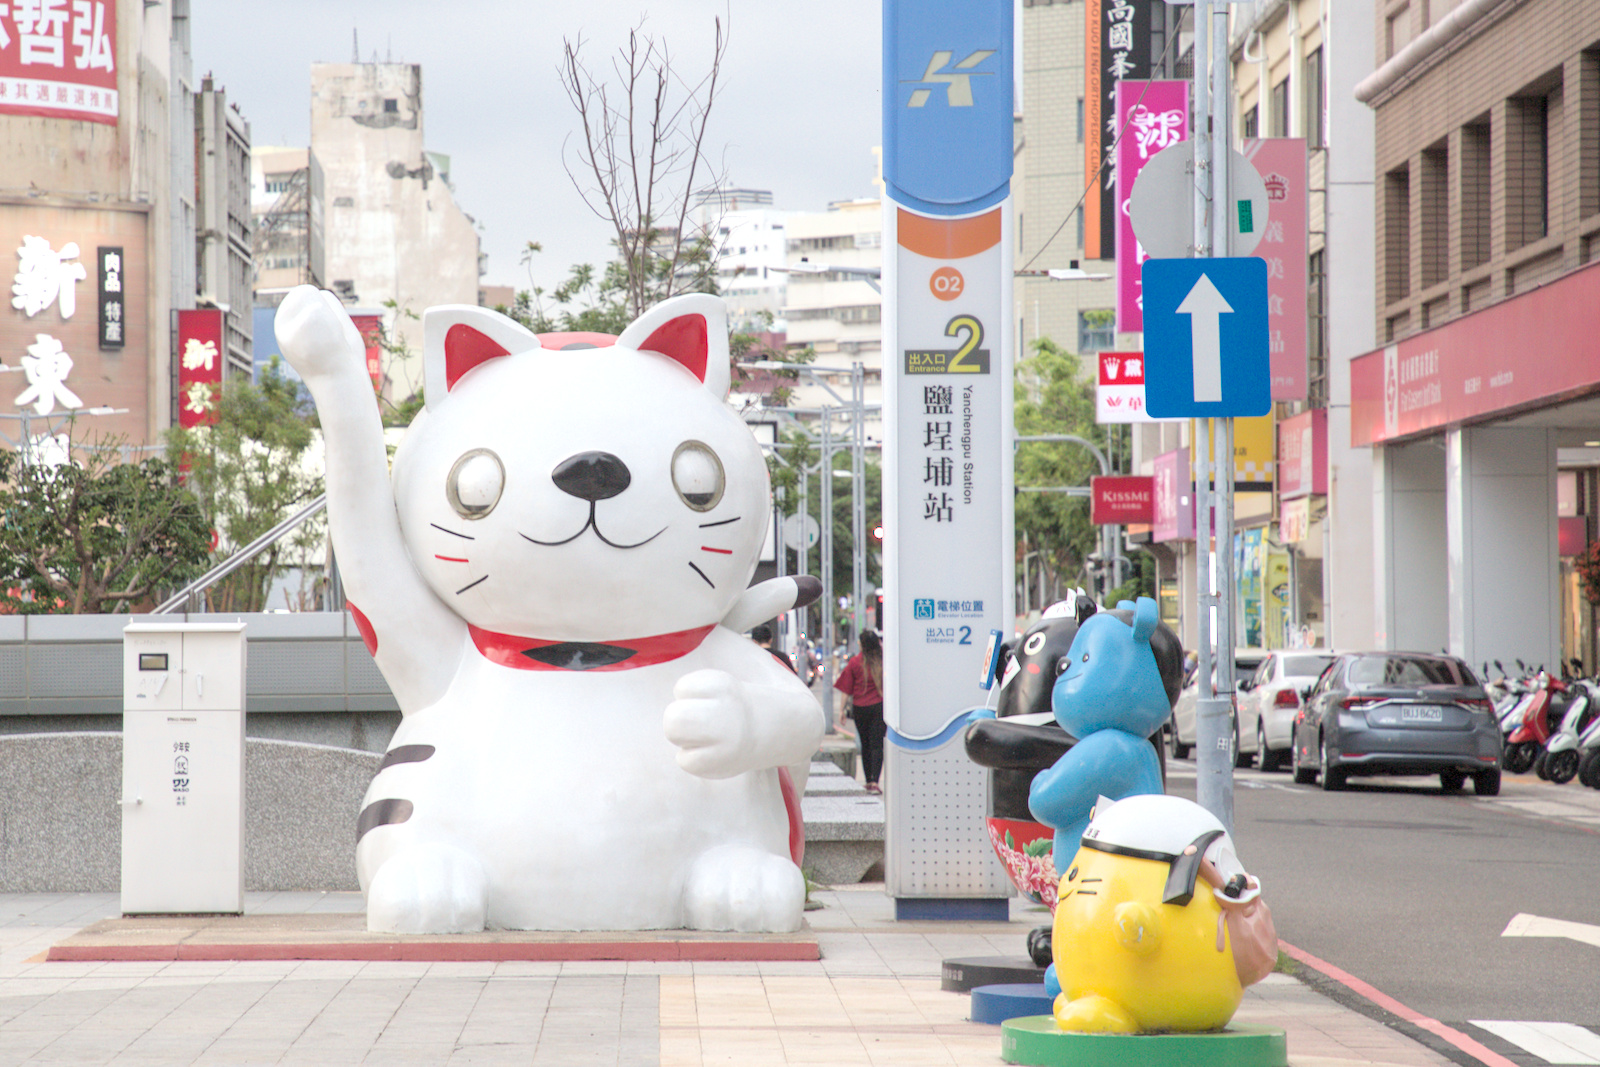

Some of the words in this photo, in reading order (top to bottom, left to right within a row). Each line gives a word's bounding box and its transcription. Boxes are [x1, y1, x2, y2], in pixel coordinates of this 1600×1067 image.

[104, 252, 121, 292] 肉品
[934, 276, 960, 292] O2
[944, 314, 984, 373] 2
[909, 353, 946, 365] 出入口
[909, 365, 946, 373] Entrance
[961, 384, 974, 459] Yanchengpu
[923, 384, 954, 523] 鹽埕埔站
[963, 462, 974, 505] Station
[937, 600, 984, 612] 電梯位置
[926, 628, 955, 637] 出入口
[958, 625, 972, 645] 2
